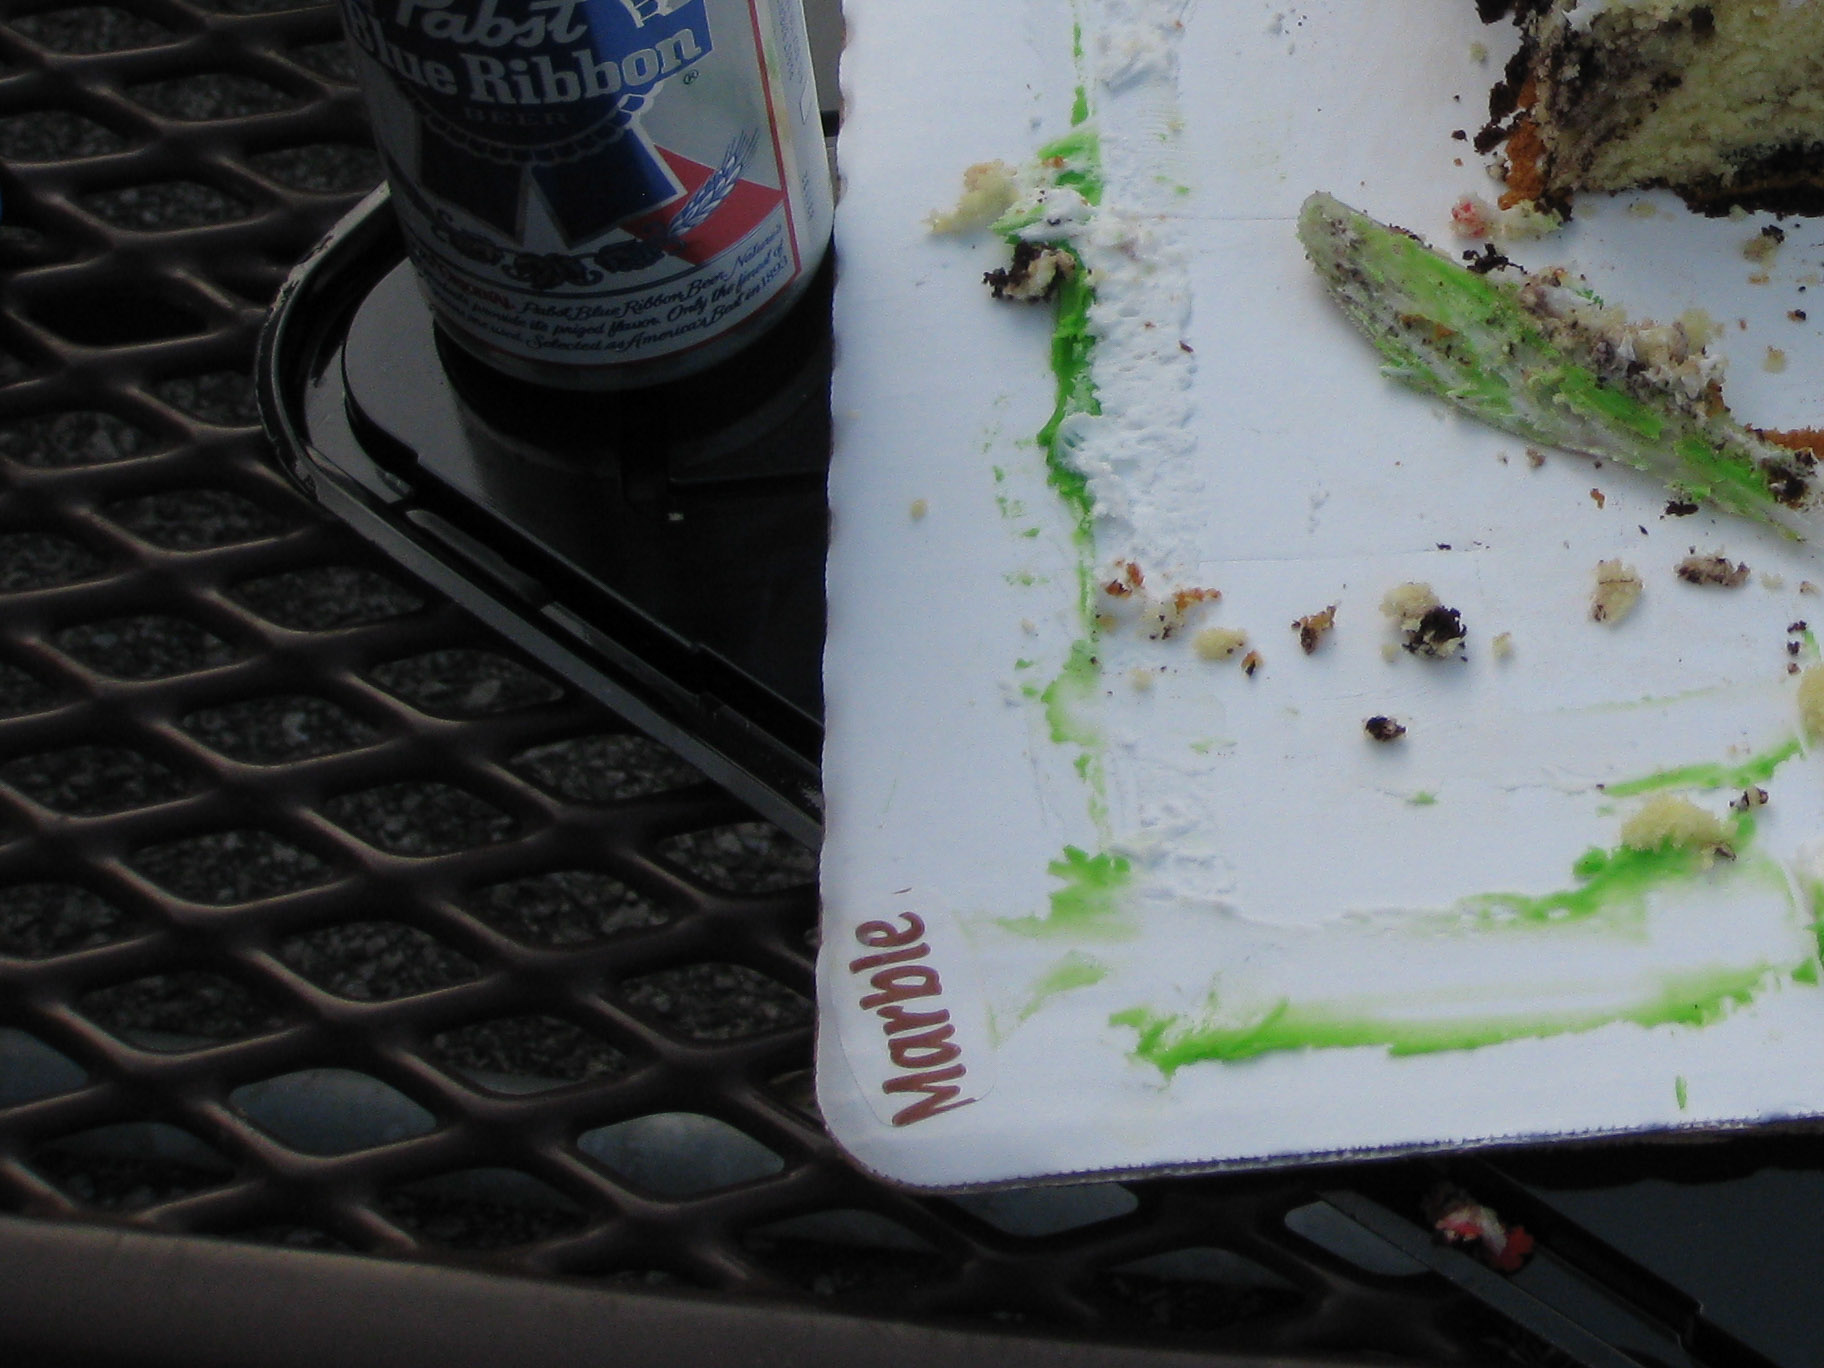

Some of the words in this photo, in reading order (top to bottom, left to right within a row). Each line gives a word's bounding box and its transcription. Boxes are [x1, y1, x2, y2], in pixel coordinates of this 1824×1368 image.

[460, 27, 701, 105] Ribbon
[616, 291, 685, 318] Ribbon
[667, 295, 707, 322] Only
[848, 911, 976, 1128] Marble
